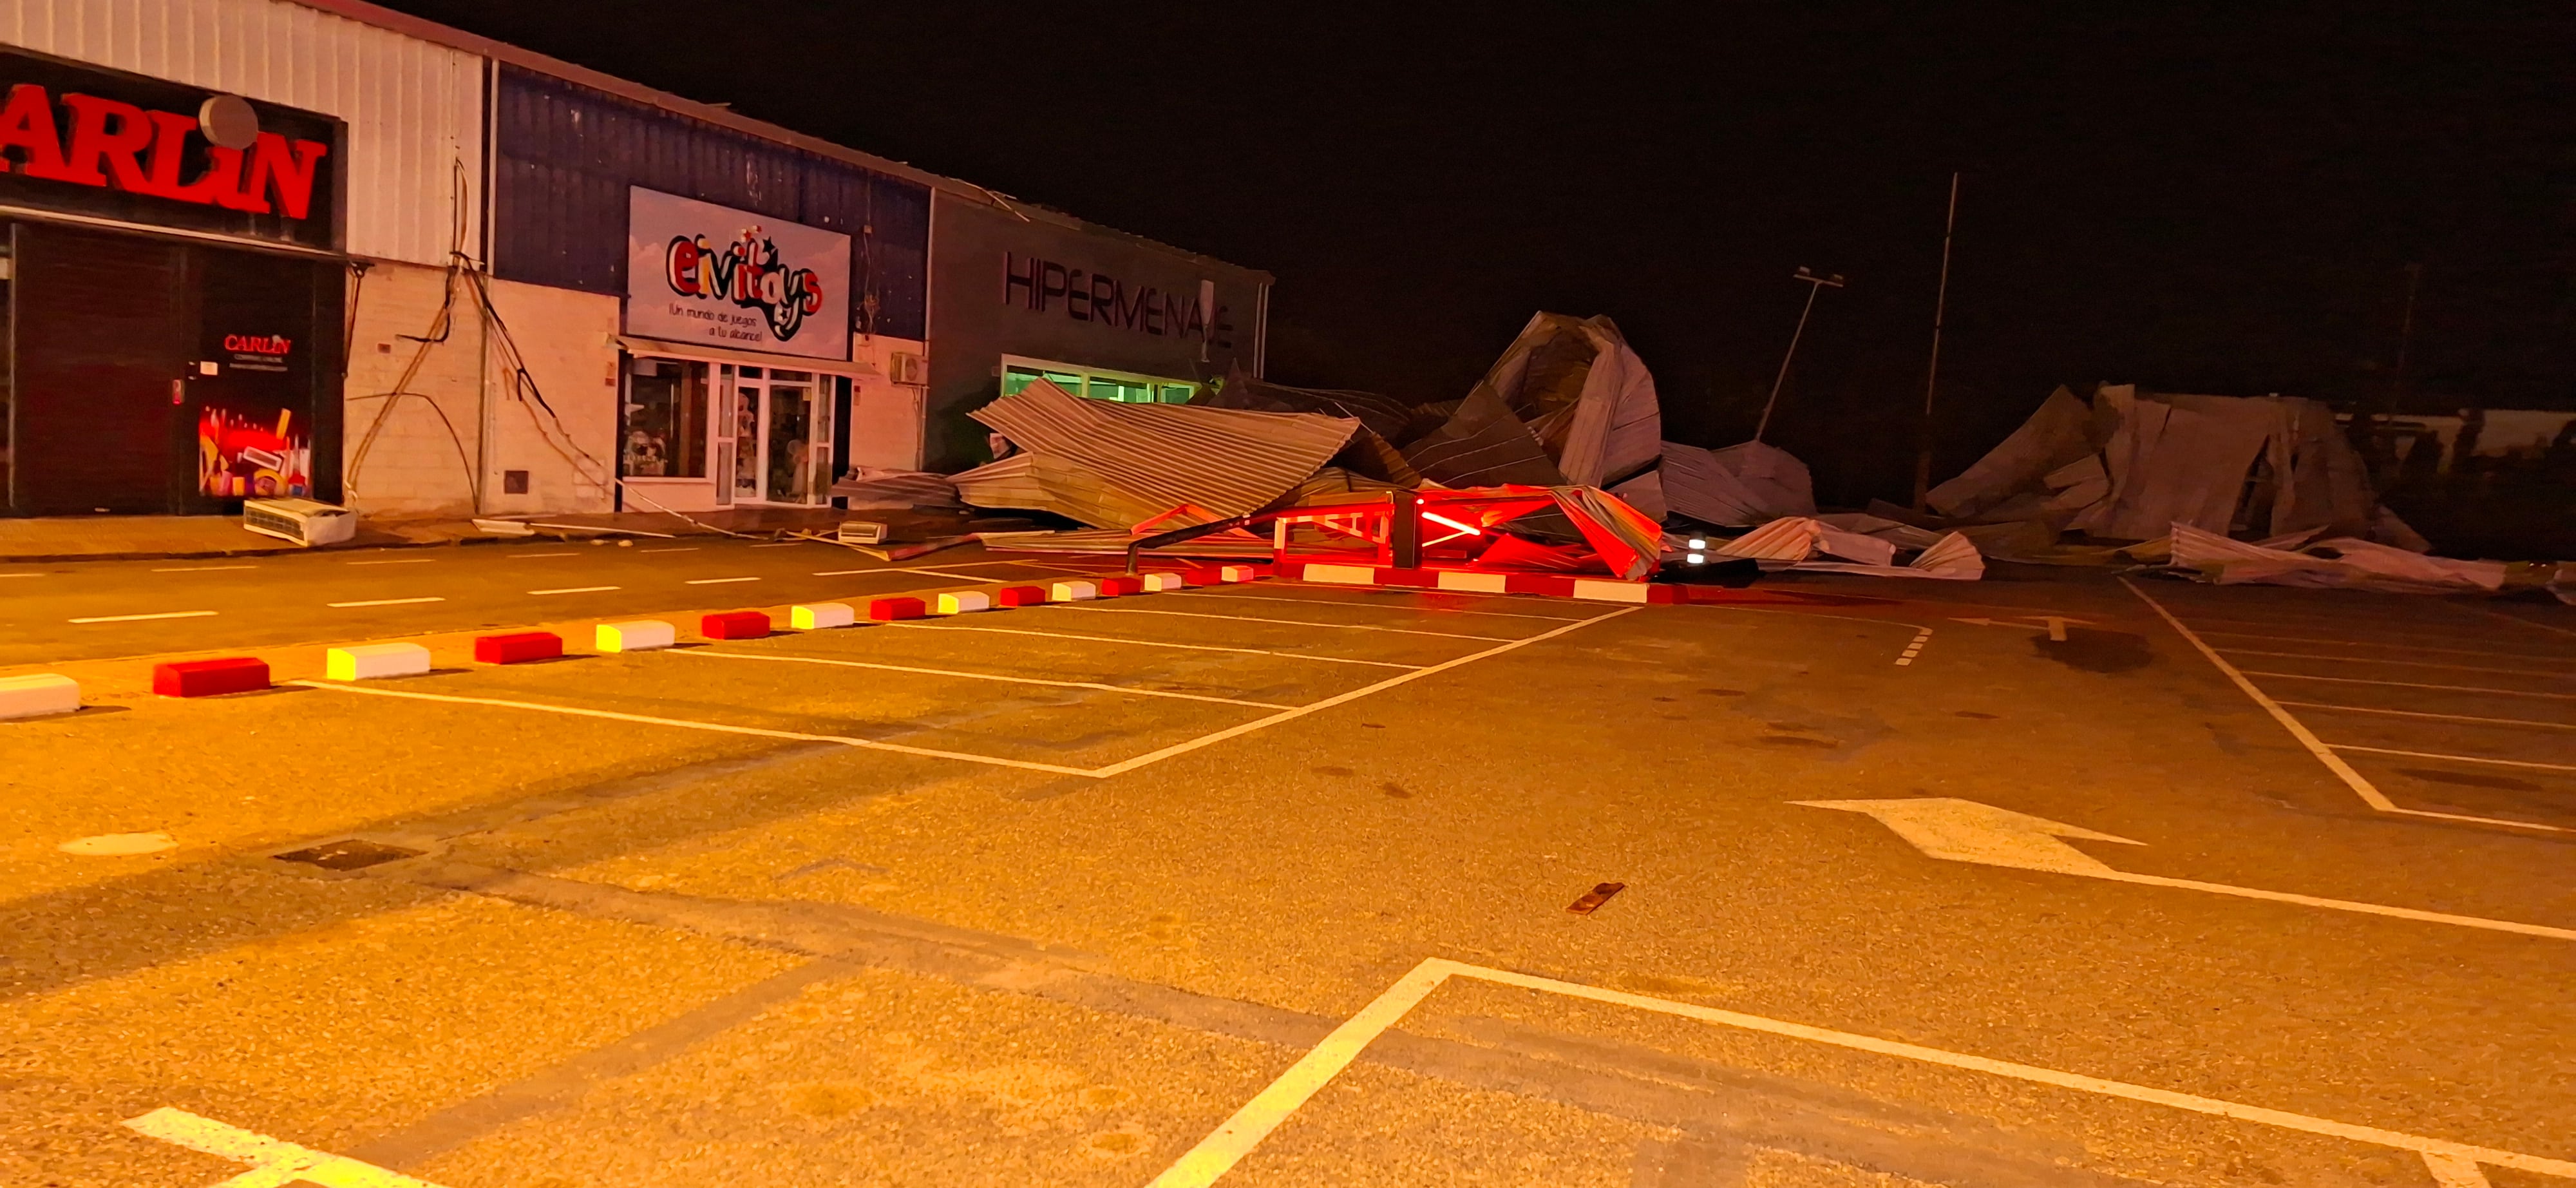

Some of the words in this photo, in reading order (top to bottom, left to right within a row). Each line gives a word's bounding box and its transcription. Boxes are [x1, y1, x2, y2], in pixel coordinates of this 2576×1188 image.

[687, 309, 715, 321] mundo
[717, 312, 728, 322] de
[730, 314, 757, 328] juegos
[709, 327, 715, 336] a
[718, 326, 727, 338] tu
